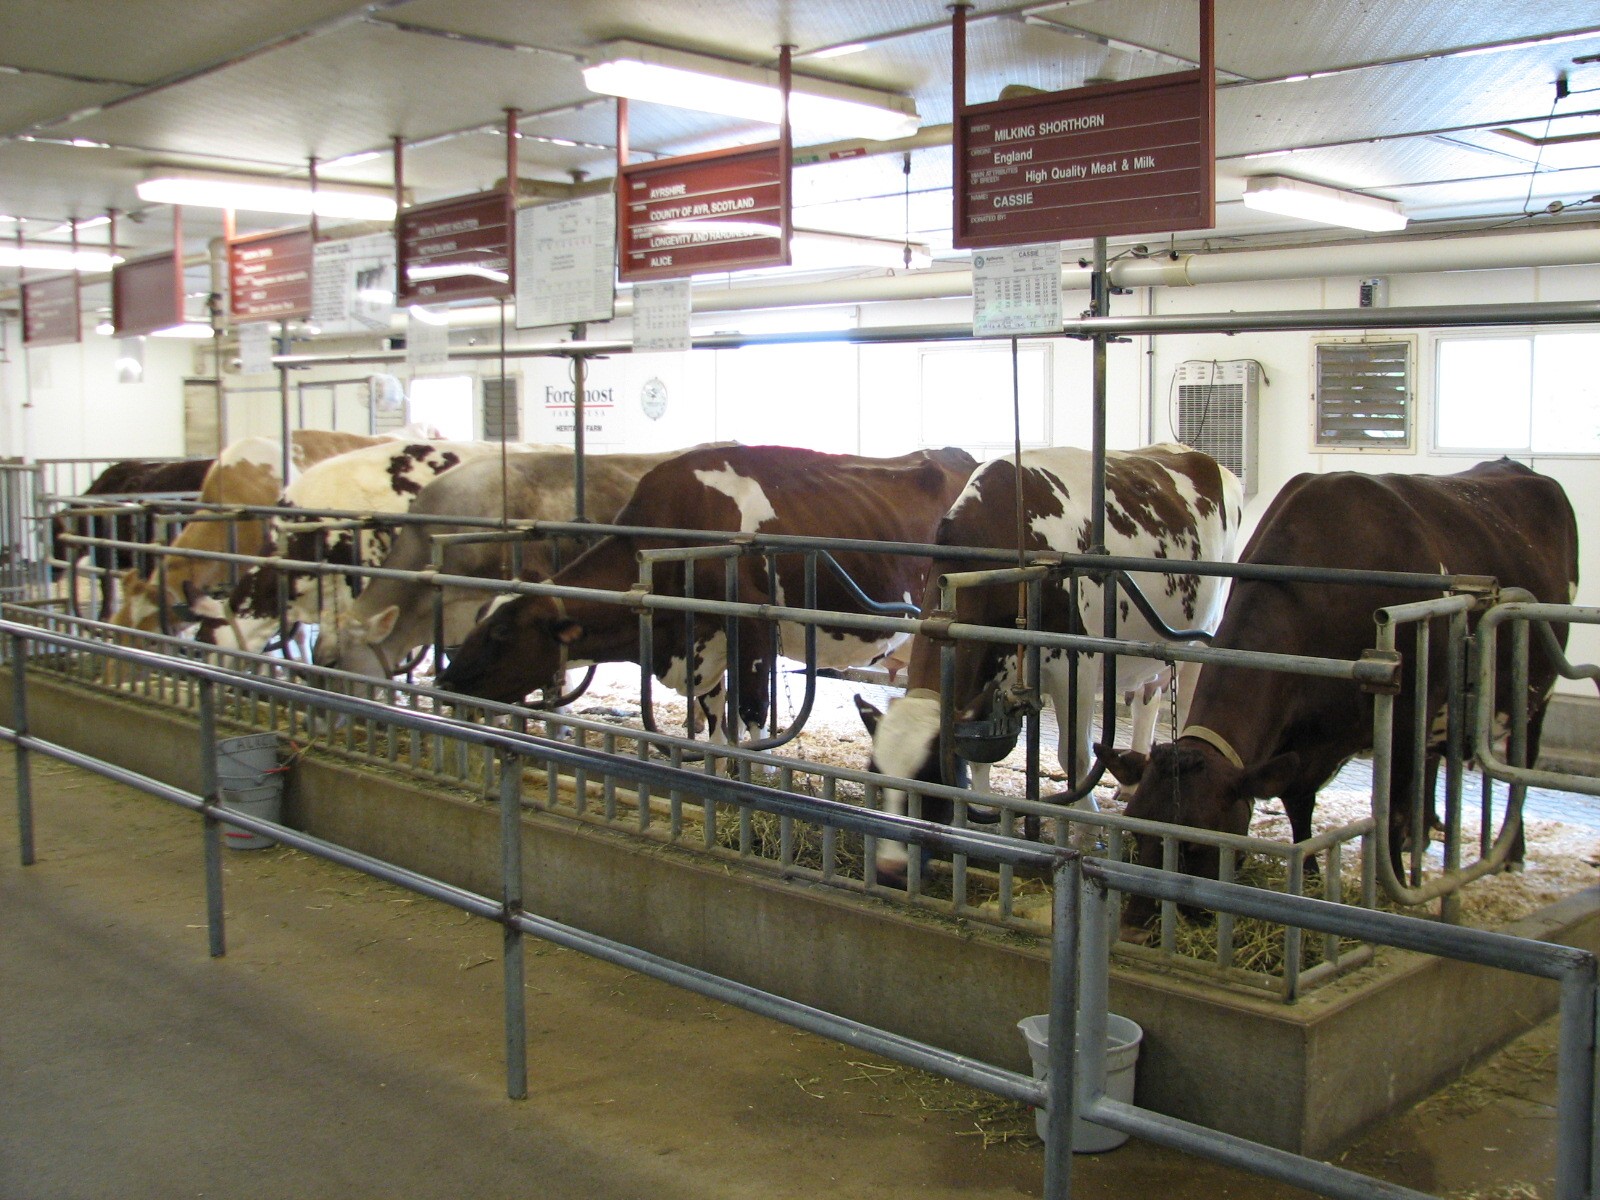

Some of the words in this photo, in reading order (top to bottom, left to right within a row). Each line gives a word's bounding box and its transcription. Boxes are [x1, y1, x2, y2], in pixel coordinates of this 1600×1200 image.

[994, 126, 1035, 142] MILKING
[1039, 114, 1105, 135] SHORTHORN
[994, 148, 1033, 165] England
[1025, 170, 1048, 184] High
[1051, 164, 1087, 180] Quality
[1091, 159, 1117, 175] Meat
[1121, 159, 1129, 171] &
[1133, 155, 1156, 170] Milk
[650, 184, 687, 199] AYRSHIRE
[993, 192, 1034, 208] CASSIE
[650, 209, 680, 222] COUNTY
[681, 207, 693, 217] OF
[693, 204, 711, 216] AYR,
[712, 197, 755, 213] SCOTLAND
[650, 235, 692, 248] LONGEVITY
[692, 232, 709, 243] AND
[650, 256, 672, 268] ALICE
[586, 424, 603, 432] FARM
